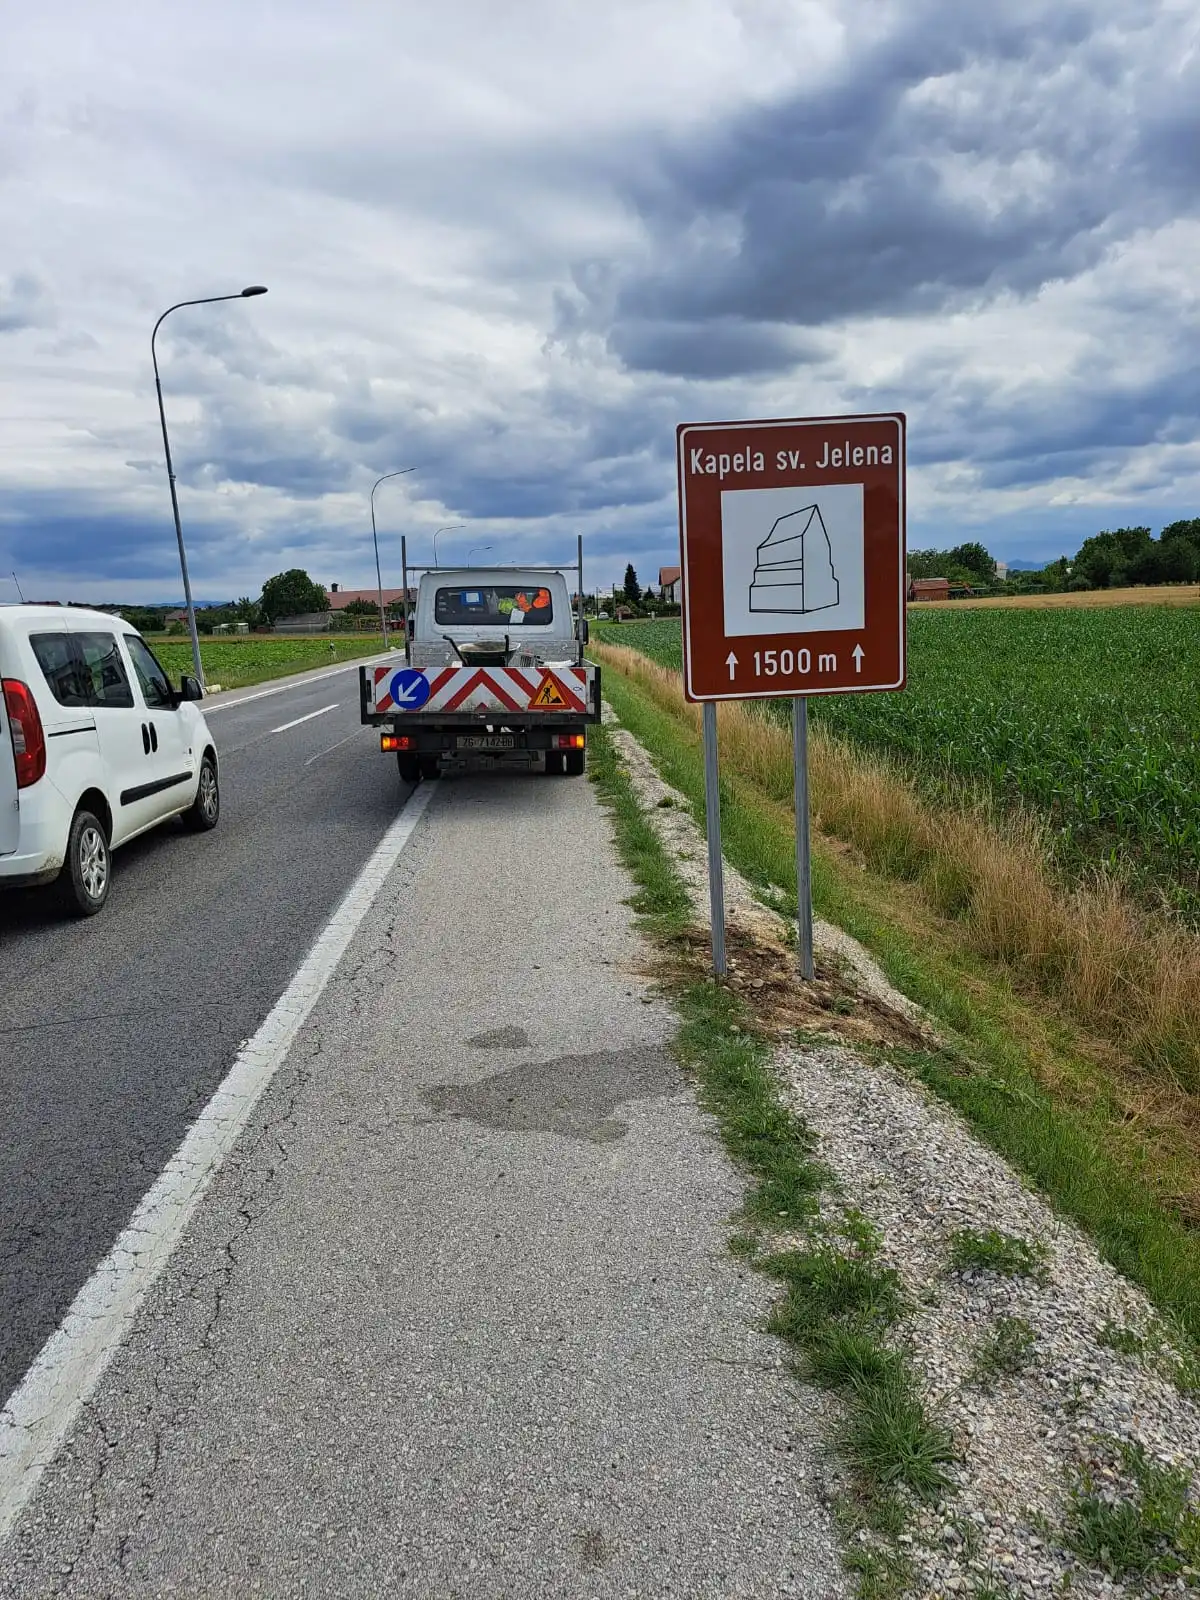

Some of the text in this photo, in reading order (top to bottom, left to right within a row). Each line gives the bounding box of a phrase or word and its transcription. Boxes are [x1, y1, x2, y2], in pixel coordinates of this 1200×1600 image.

[690, 441, 893, 480] Kapela sv. Jelena
[753, 648, 837, 676] 1500 m
